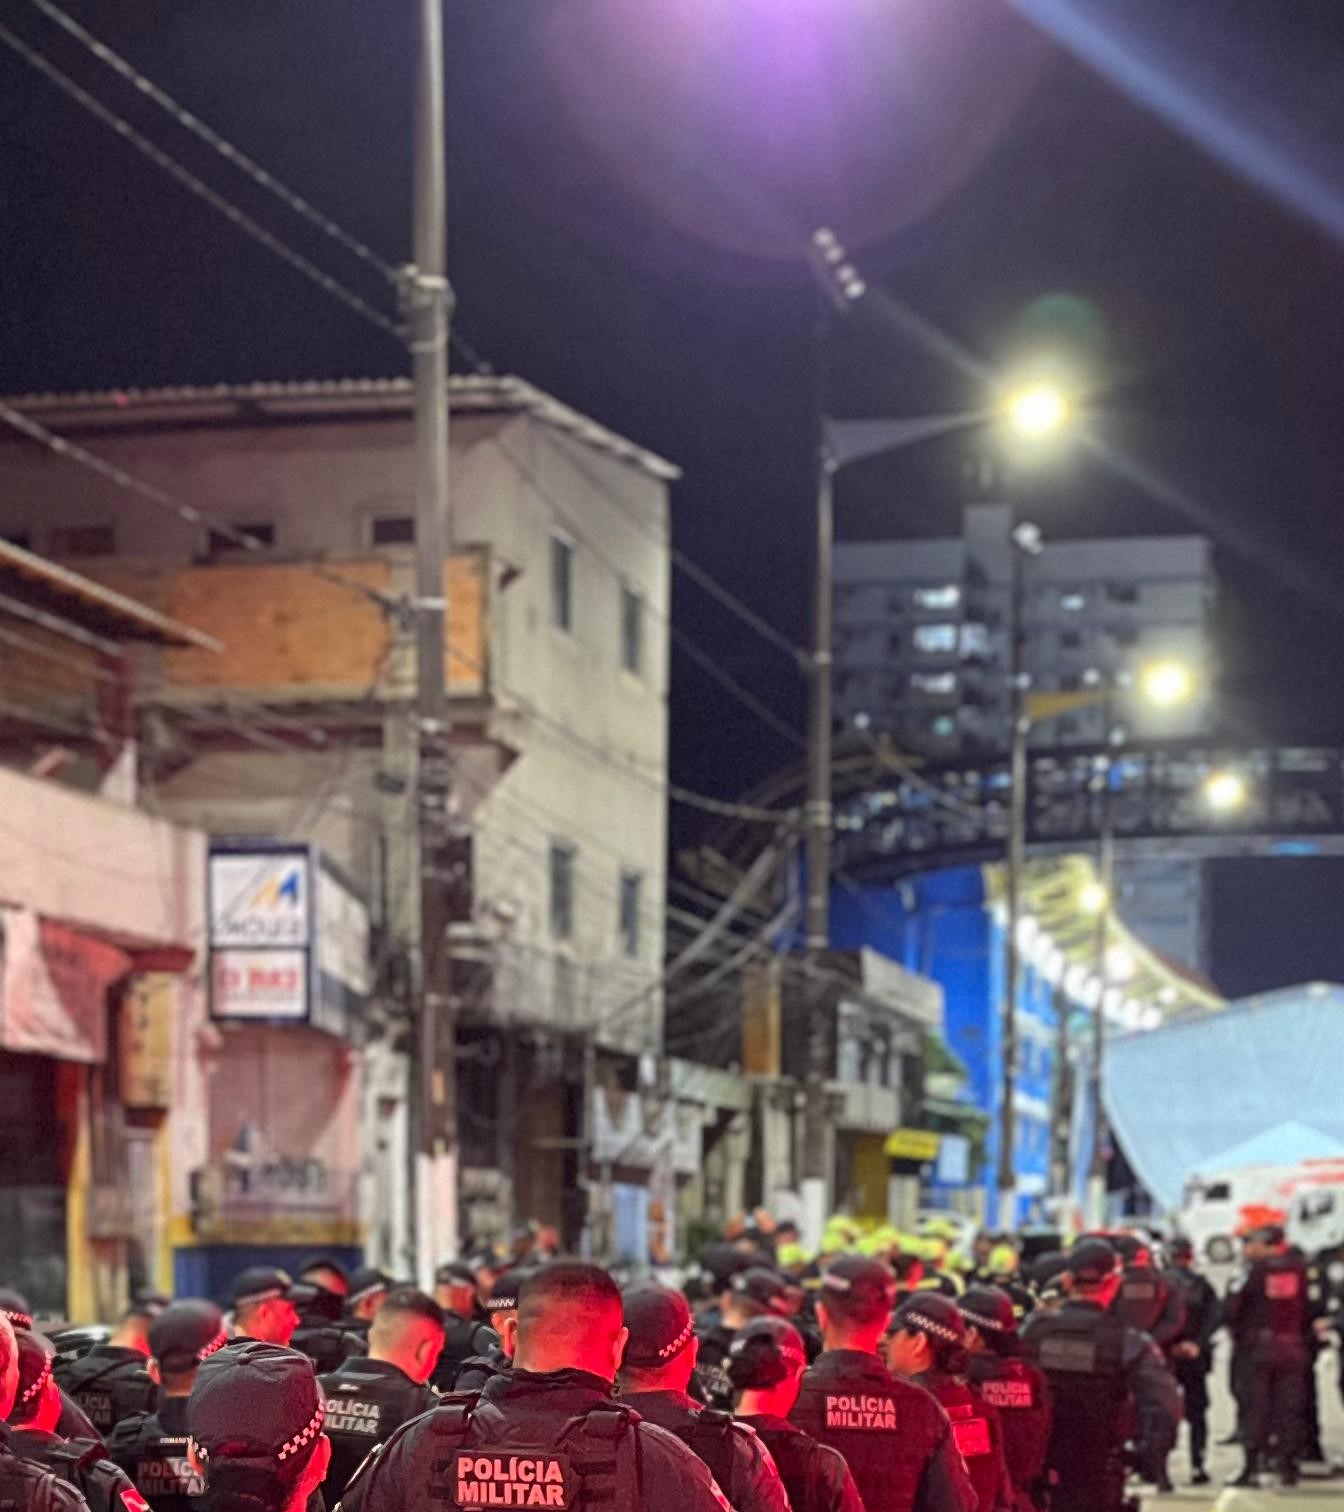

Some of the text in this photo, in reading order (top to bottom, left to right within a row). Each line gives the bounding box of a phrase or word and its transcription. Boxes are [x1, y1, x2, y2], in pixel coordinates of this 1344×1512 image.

[323, 1399, 380, 1419] OLÍCIA
[827, 1395, 896, 1413] POLÍCIA
[323, 1414, 378, 1434] ILITAR
[827, 1411, 897, 1429] MILITAR
[457, 1456, 564, 1483] POLÍCIA
[457, 1480, 565, 1506] MILITAR
